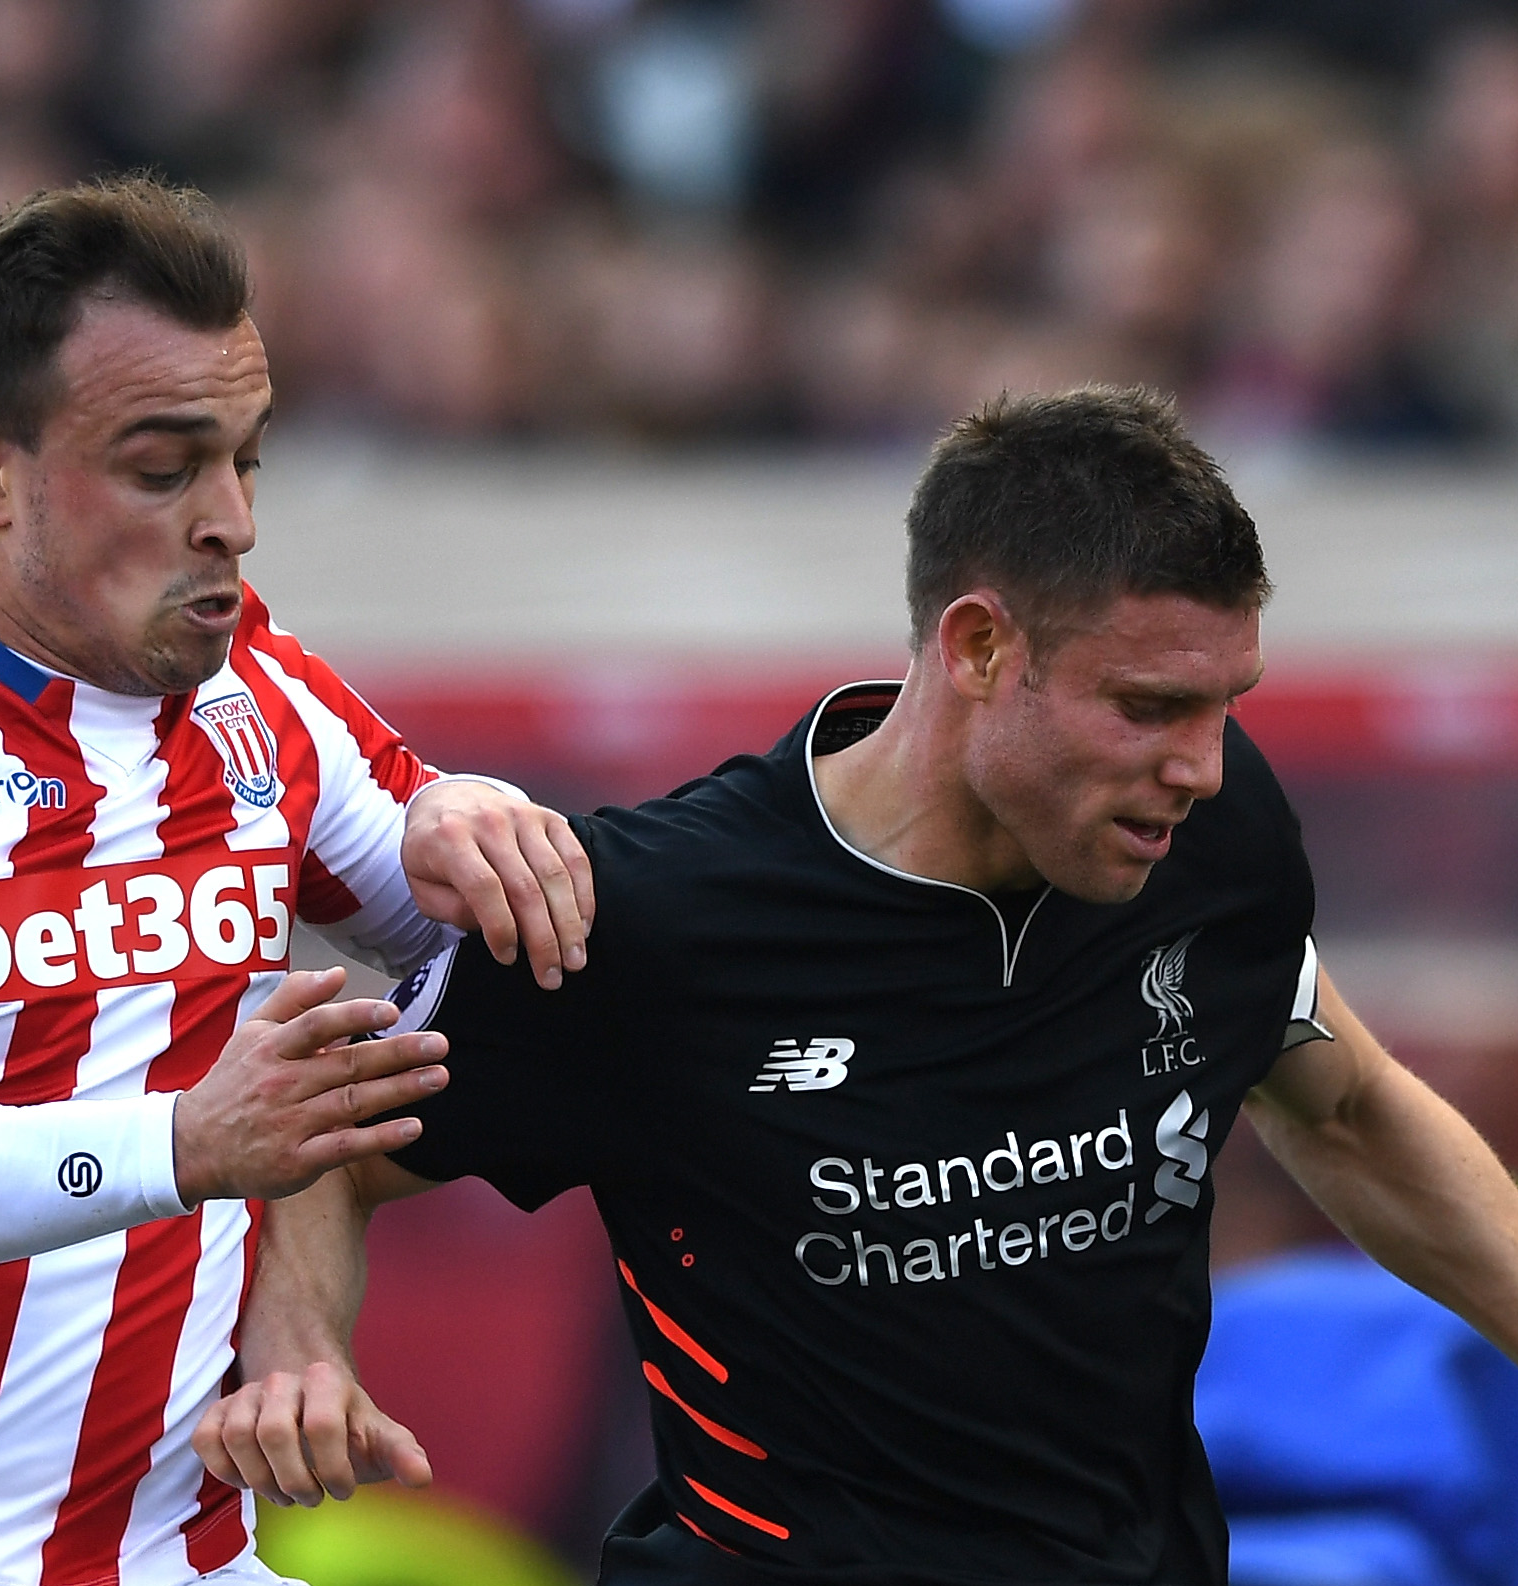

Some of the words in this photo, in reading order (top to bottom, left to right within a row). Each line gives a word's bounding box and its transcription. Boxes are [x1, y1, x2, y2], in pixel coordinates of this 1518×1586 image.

[204, 699, 251, 720] STOKE
[225, 716, 246, 728] CITY
[748, 1038, 855, 1092] NB
[1141, 1038, 1206, 1077] L.F.C.
[809, 1108, 1134, 1215] Standard
[795, 1183, 1135, 1286] Chartered
